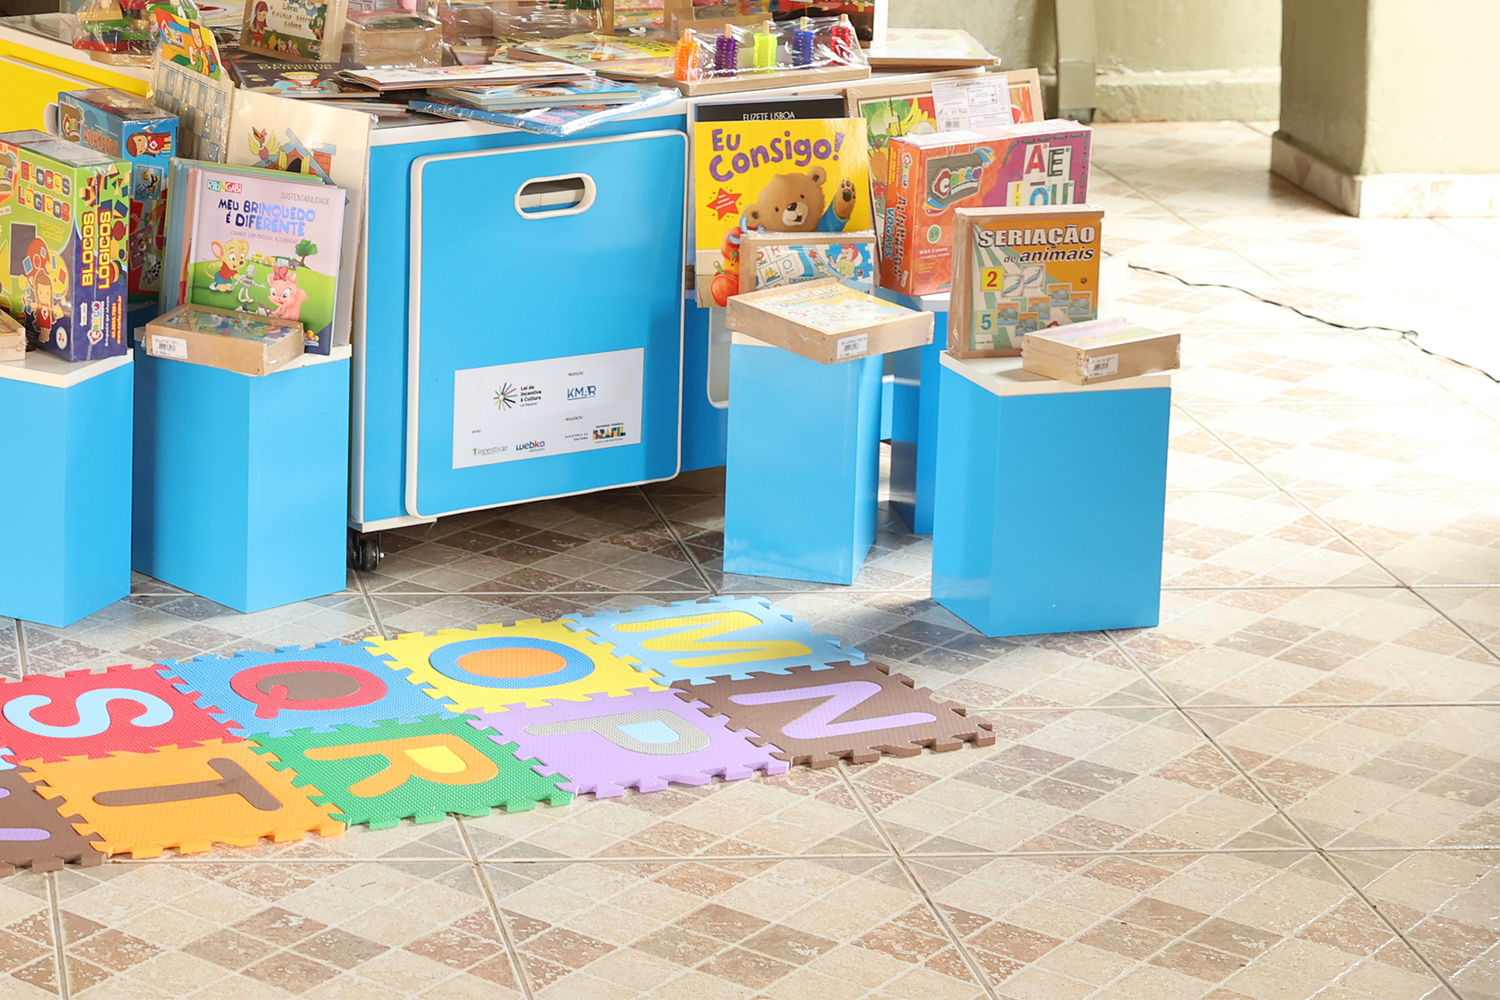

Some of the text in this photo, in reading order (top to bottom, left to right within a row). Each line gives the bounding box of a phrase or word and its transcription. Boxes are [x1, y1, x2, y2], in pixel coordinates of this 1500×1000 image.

[742, 111, 796, 121] ELIZETE LISBOA
[709, 130, 846, 182] Consigo!
[711, 128, 741, 151] Eu
[20, 160, 72, 198] BLOCOS
[280, 192, 330, 206] SUSTENTABILIDADE
[17, 183, 72, 223] LÓGICOS
[218, 199, 316, 222] MEU BRINQUEDO
[225, 211, 306, 237] É DIFERENTE
[80, 210, 112, 290] BLOCOS LÓGICOS
[884, 207, 896, 260] VOGAIS
[978, 224, 1096, 248] SERIAÇÃO
[1003, 246, 1094, 263] de animais
[986, 270, 998, 288] 2
[981, 314, 992, 331] 5
[611, 610, 814, 668] M
[428, 636, 596, 689] O
[230, 660, 388, 720] Q
[728, 681, 937, 740] N
[3, 688, 174, 739] S
[523, 709, 713, 756] P
[93, 757, 284, 812] T
[303, 733, 499, 798] R
